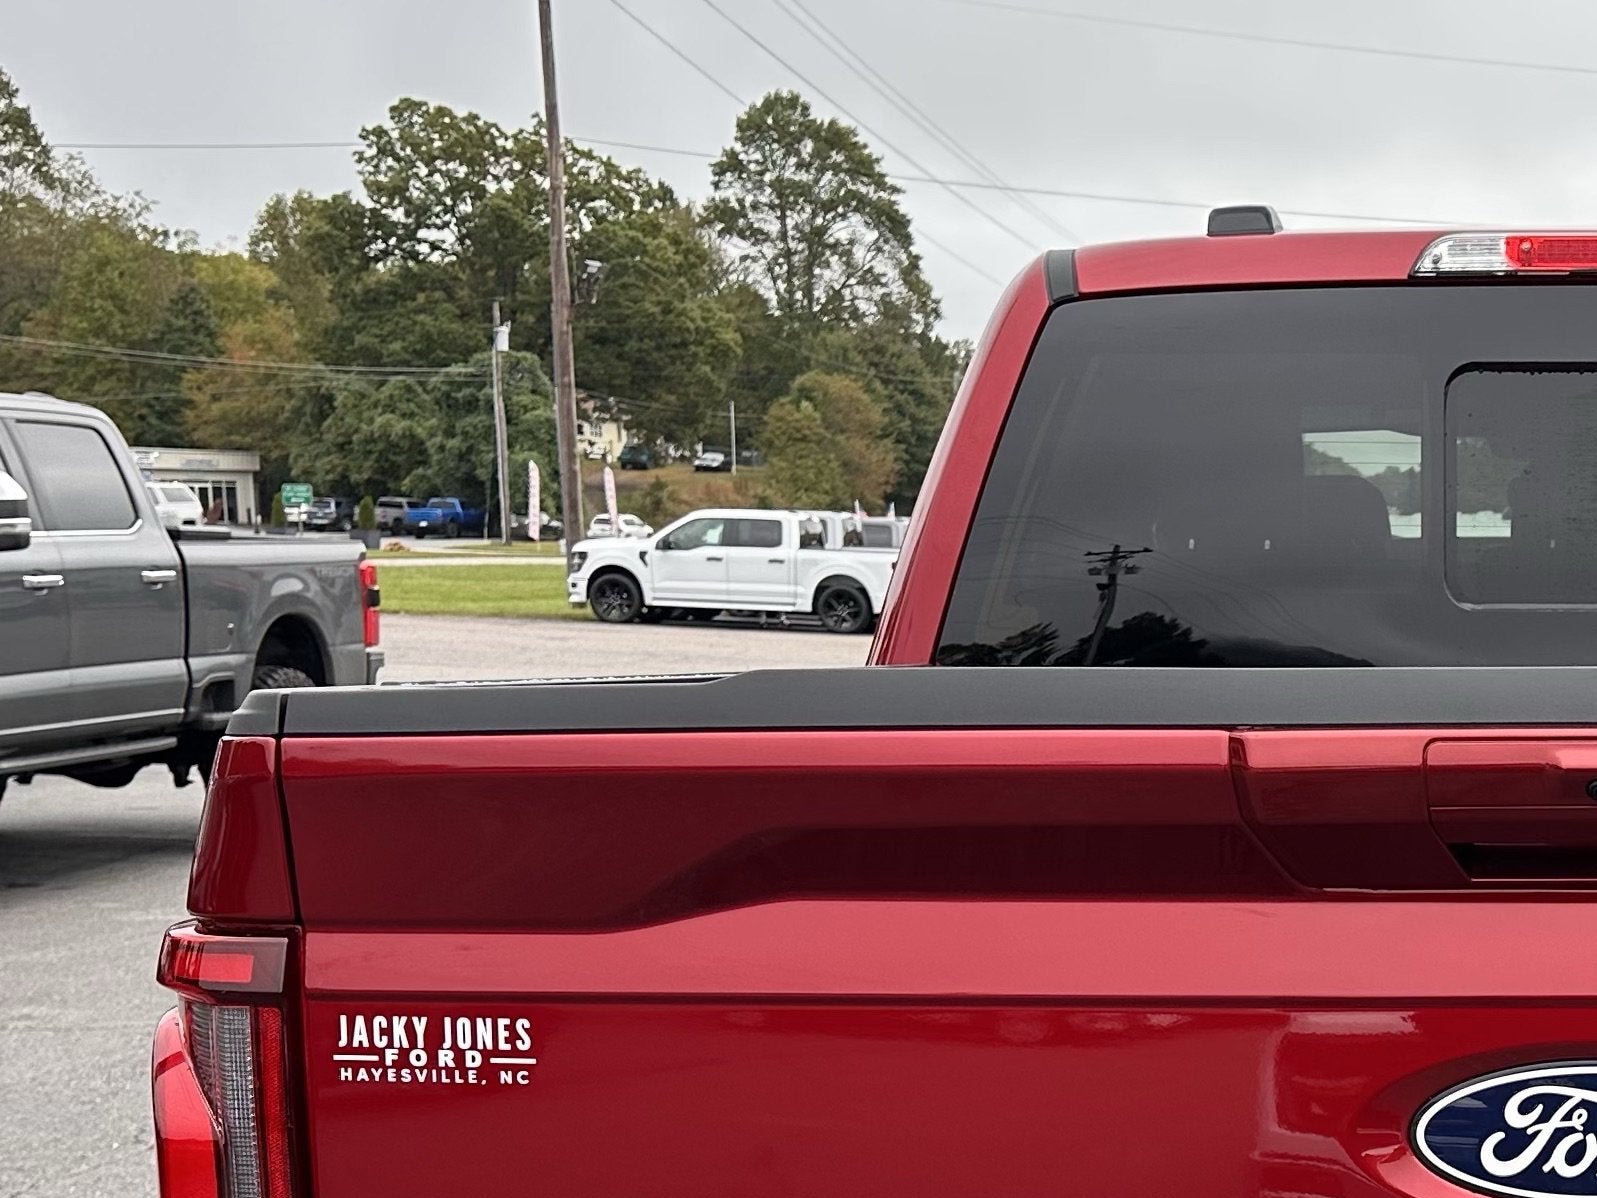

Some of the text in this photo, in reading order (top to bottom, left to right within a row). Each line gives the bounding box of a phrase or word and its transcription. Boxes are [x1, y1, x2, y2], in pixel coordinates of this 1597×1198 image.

[338, 1014, 532, 1051] JACKY JONES
[384, 1048, 483, 1069] FORD
[339, 1067, 530, 1086] HAYESVILLE, NC
